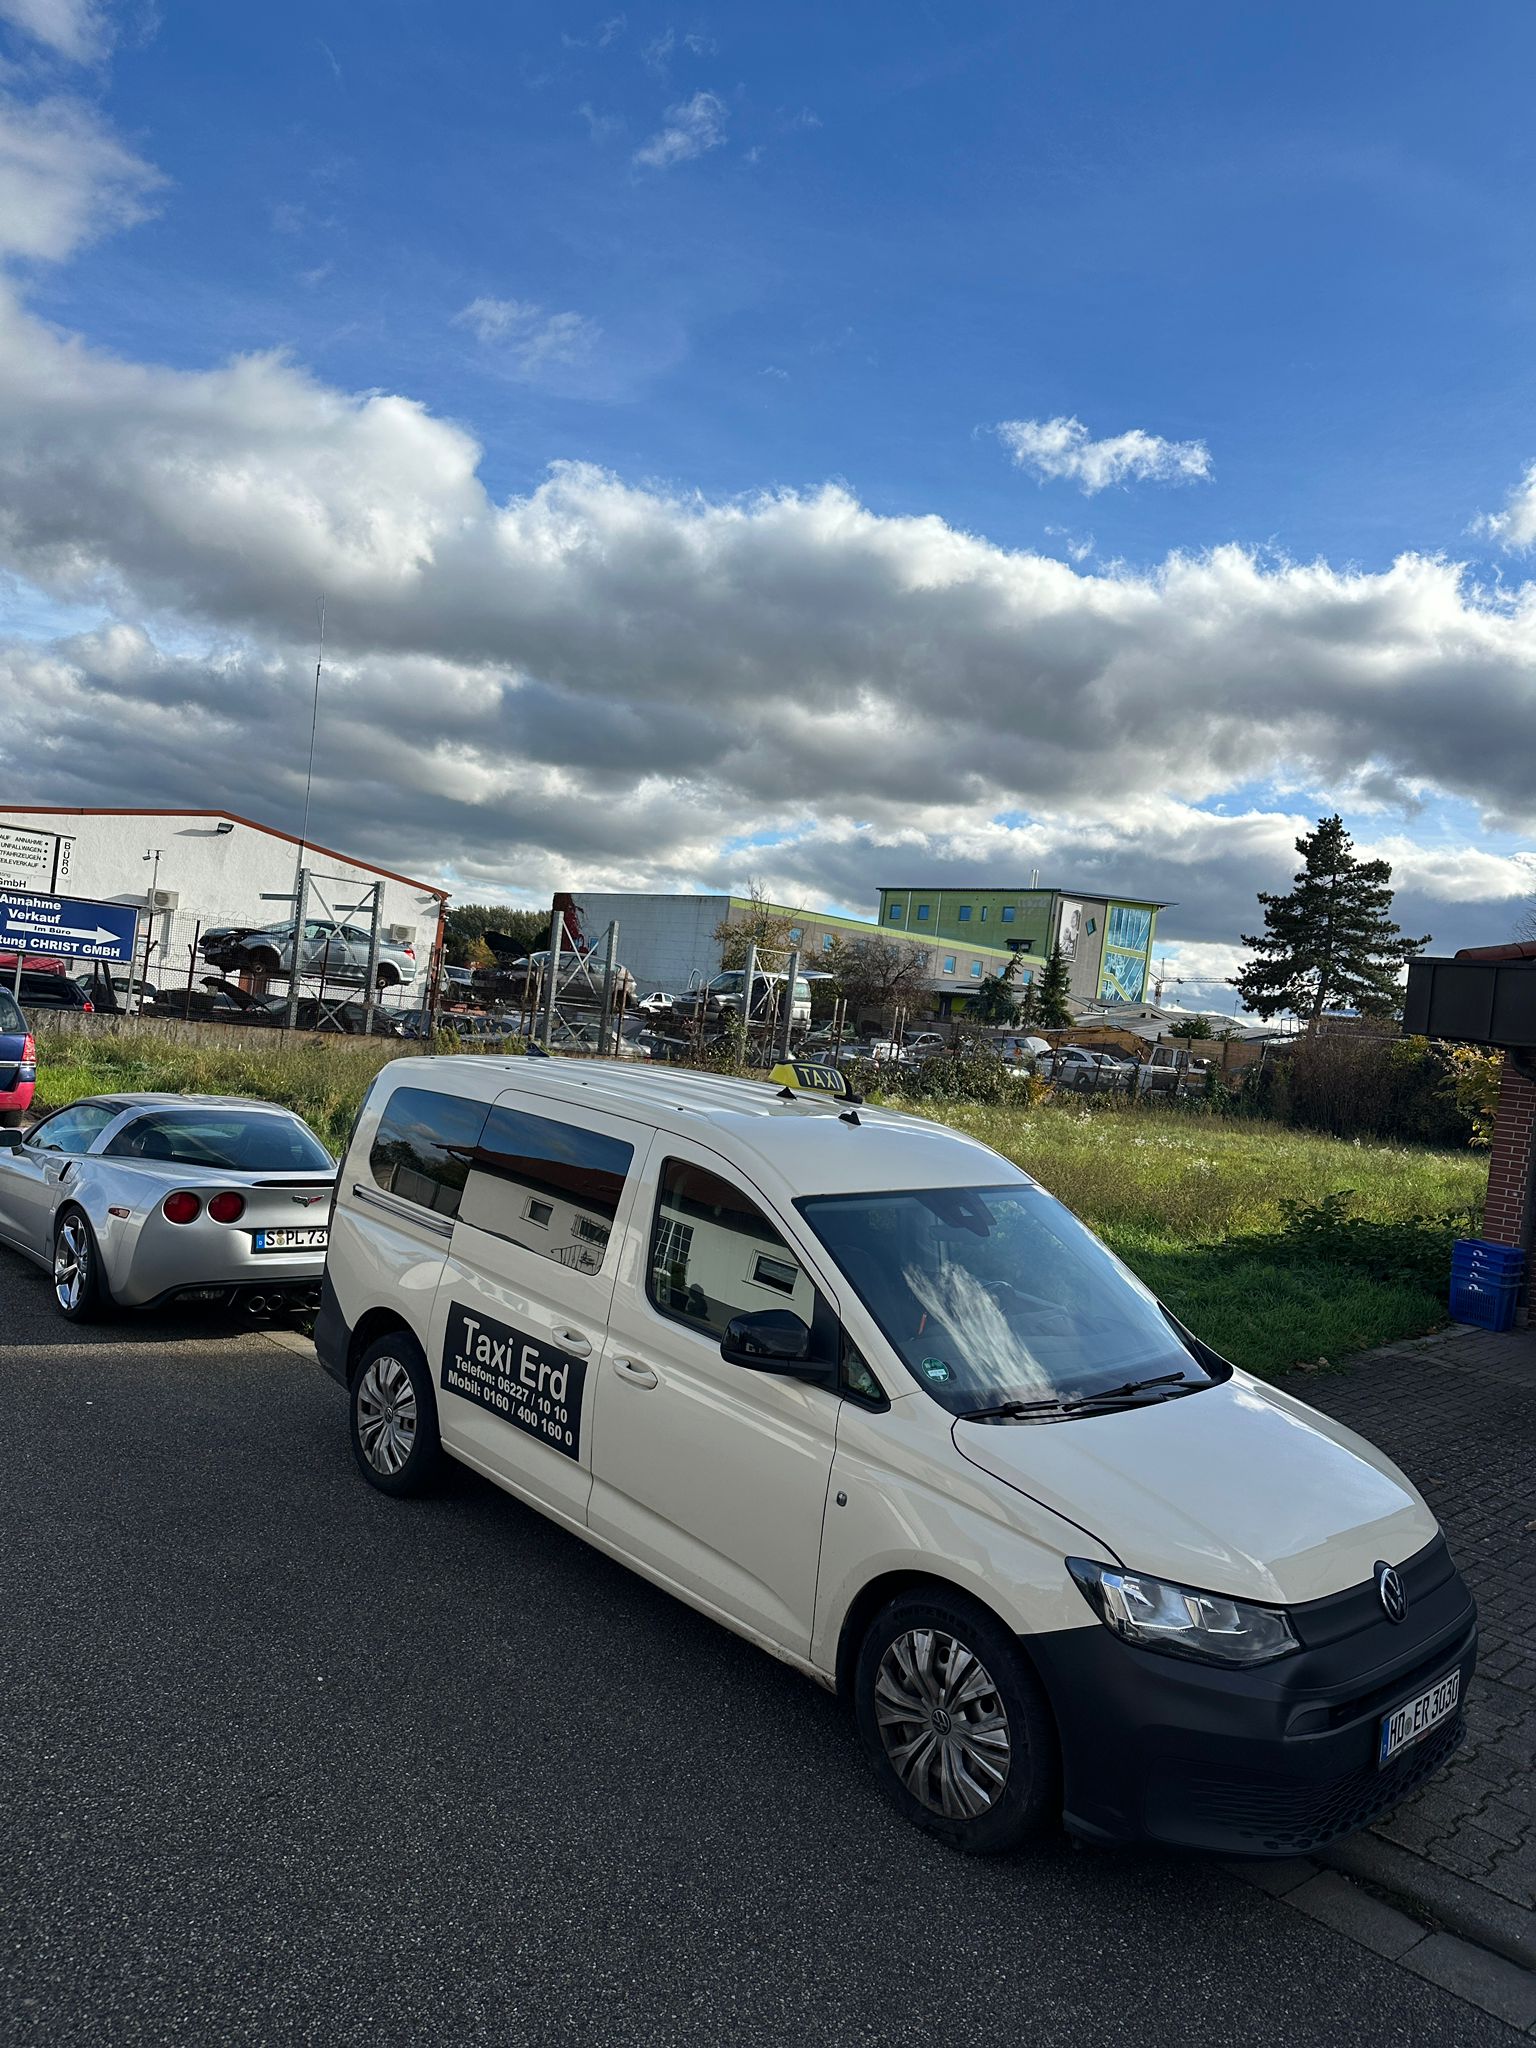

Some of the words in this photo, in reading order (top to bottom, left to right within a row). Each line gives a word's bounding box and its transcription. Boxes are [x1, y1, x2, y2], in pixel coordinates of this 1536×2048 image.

[1, 842, 42, 853] UNFALLWAGEN
[15, 836, 43, 846] ANNAHME
[0, 857, 38, 868] EILEVERKAUF
[61, 842, 71, 875] BÜRO
[0, 893, 61, 910] Annahme
[8, 908, 61, 924] Verkauf
[49, 927, 71, 935] Büro
[30, 938, 79, 952] CHRIST
[82, 944, 120, 957] GMBH
[799, 1067, 840, 1089] TAXI
[266, 1231, 275, 1245] S
[286, 1230, 304, 1245] PL
[308, 1229, 328, 1244] 73
[463, 1317, 514, 1375] Taxi
[519, 1345, 569, 1403] Erd
[455, 1355, 495, 1385] Telefon:
[498, 1376, 529, 1402] 06227
[538, 1397, 550, 1414] 10
[554, 1407, 567, 1424] 10
[448, 1370, 480, 1396] Mobil:
[484, 1387, 509, 1411] 0160
[517, 1406, 538, 1427] 400
[541, 1418, 562, 1440] 160
[565, 1430, 573, 1446] 0
[1389, 1711, 1405, 1750] HD
[1413, 1695, 1430, 1732] ER
[1432, 1674, 1458, 1719] 3030
